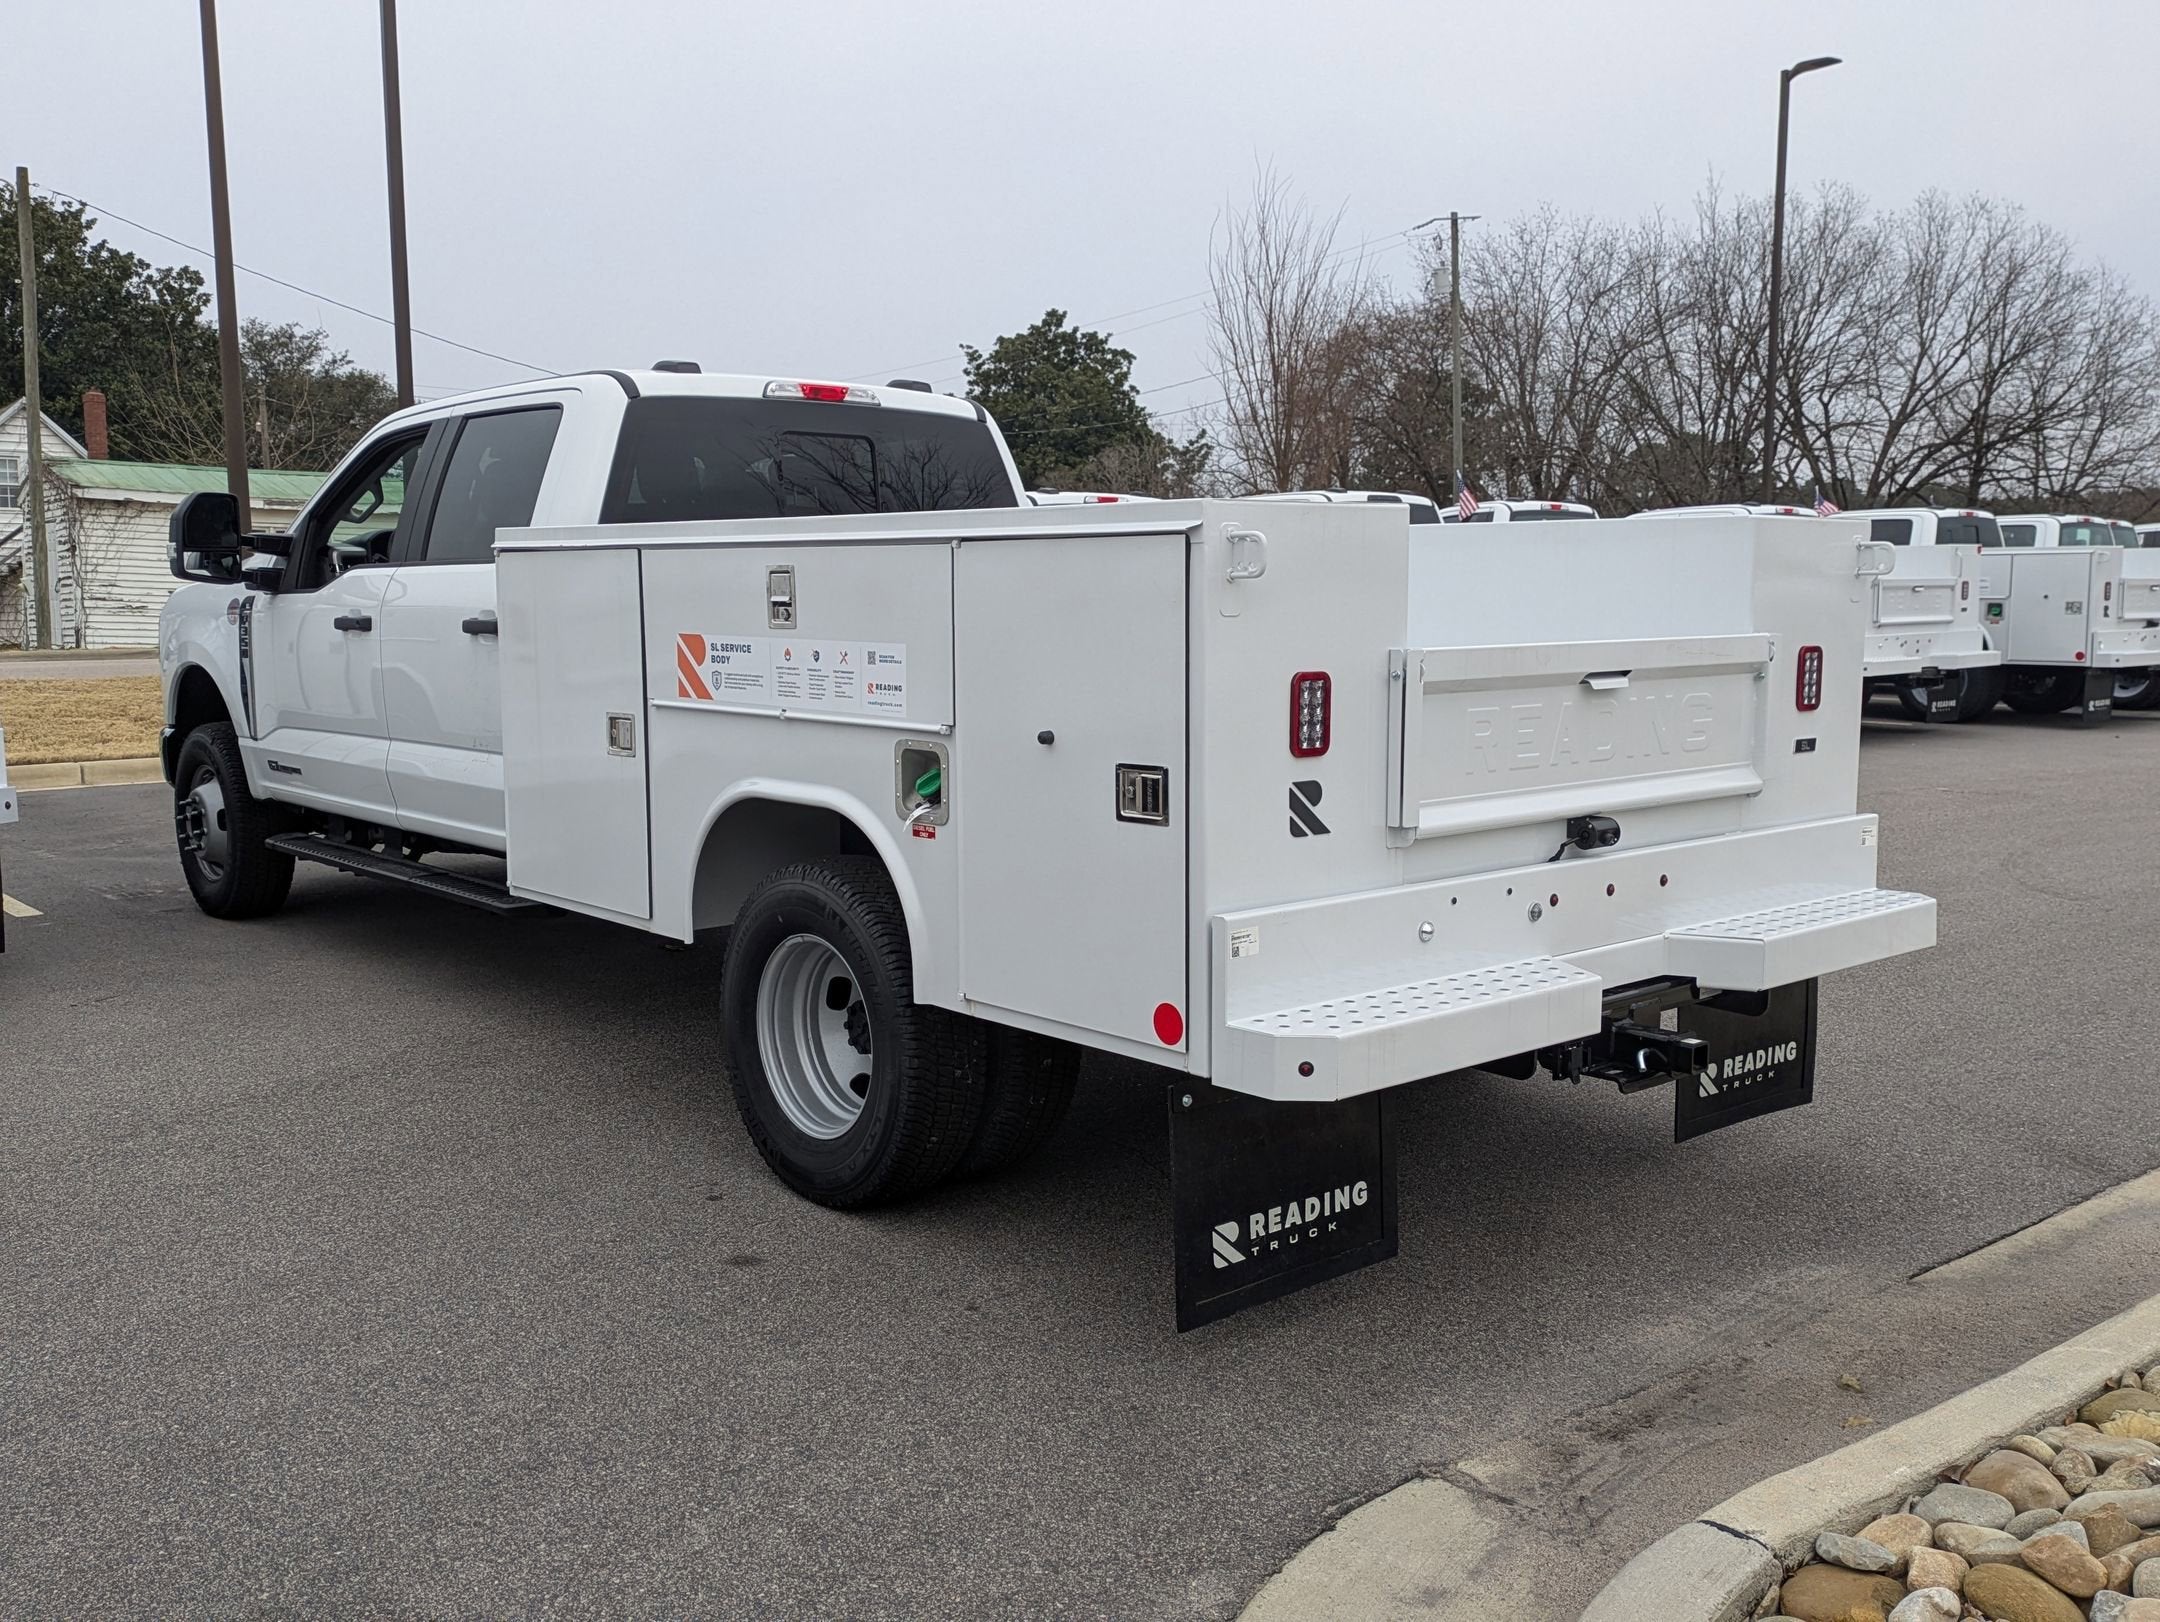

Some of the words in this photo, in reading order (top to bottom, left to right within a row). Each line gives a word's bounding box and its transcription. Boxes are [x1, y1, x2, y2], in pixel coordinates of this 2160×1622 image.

[710, 642, 720, 652] SL
[720, 643, 752, 654] SERVICE
[711, 654, 731, 664] BODY
[875, 683, 903, 692] READING
[1465, 692, 1714, 776] READING
[1722, 1041, 1798, 1079] READING
[1722, 1070, 1776, 1092] TRUCK
[1249, 1180, 1369, 1240] READING
[1250, 1221, 1338, 1257] TRUCK
